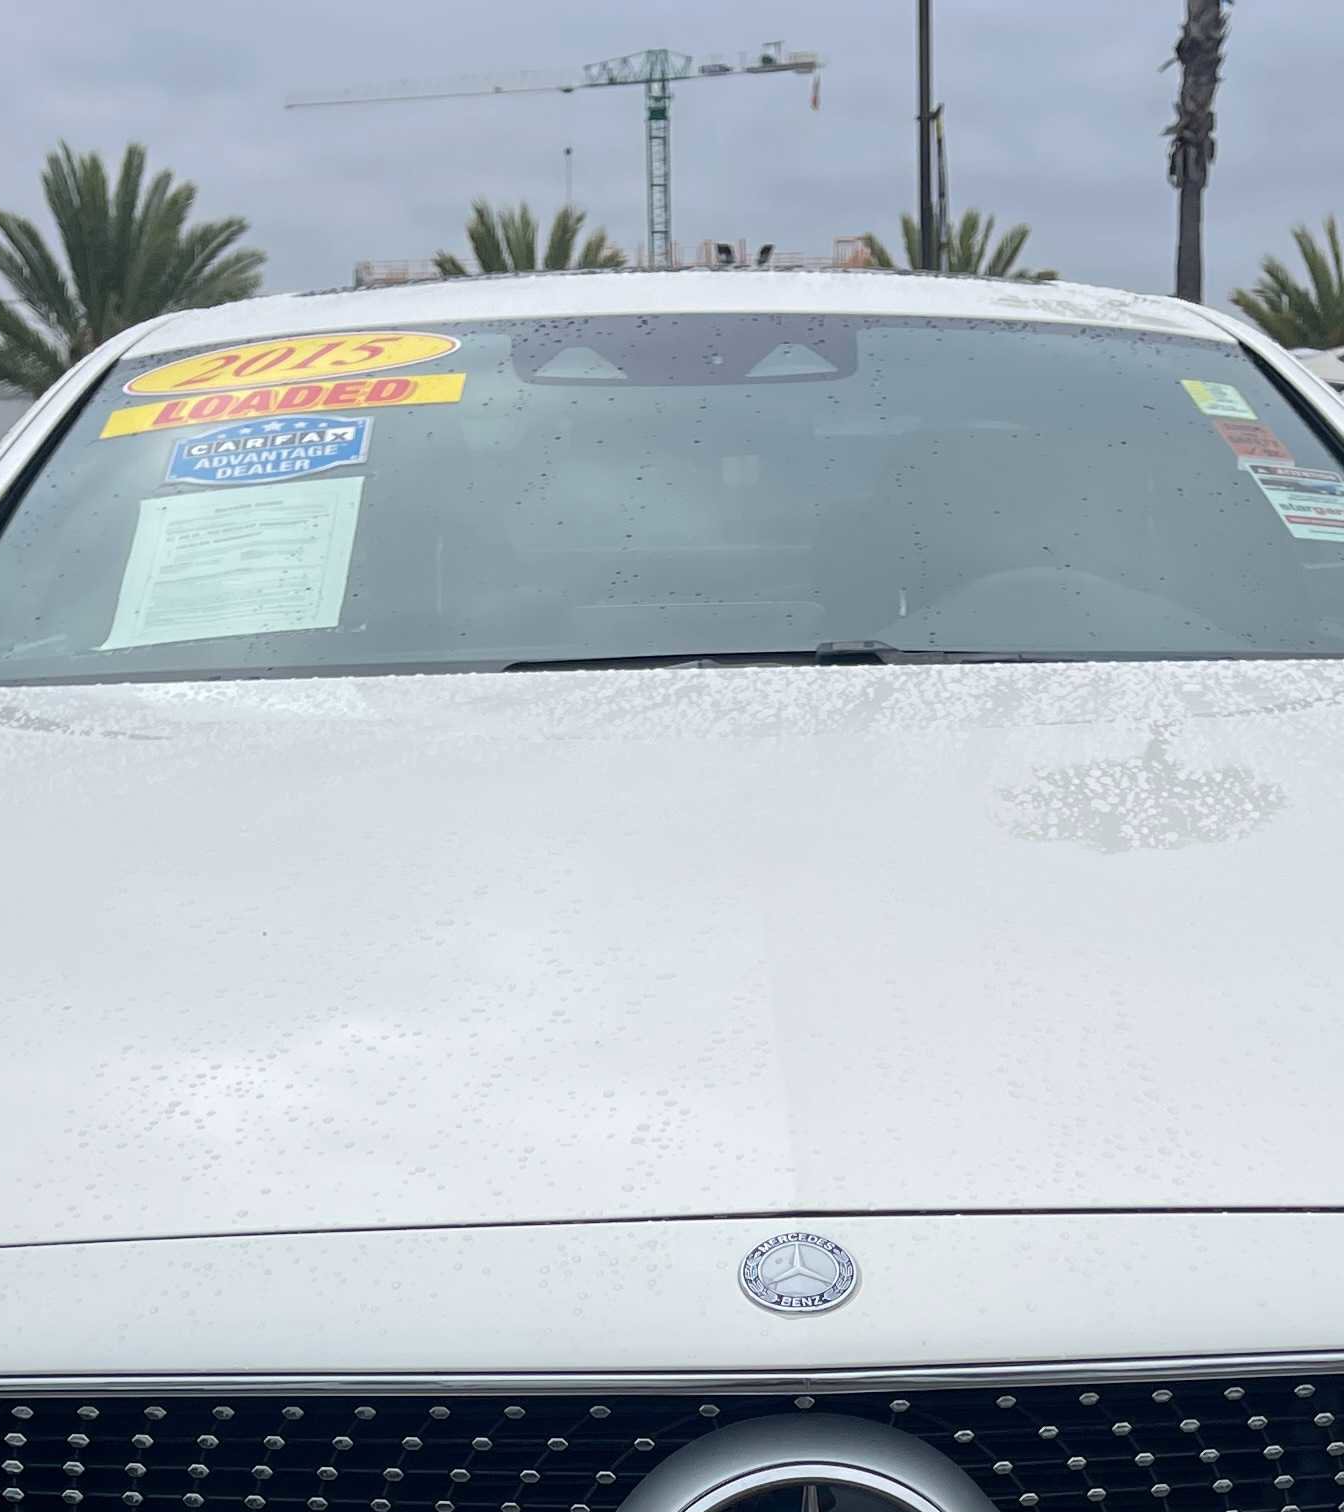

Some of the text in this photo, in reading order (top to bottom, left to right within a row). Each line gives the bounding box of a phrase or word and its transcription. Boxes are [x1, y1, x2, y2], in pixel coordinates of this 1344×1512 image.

[174, 336, 404, 389] 2015
[152, 378, 418, 426] LOADED
[188, 428, 354, 457] CARFAX
[193, 444, 339, 470] ADVANTAGE
[215, 459, 311, 480] DEALER
[758, 1232, 836, 1254] MERCEDES
[780, 1295, 824, 1308] BENZ
